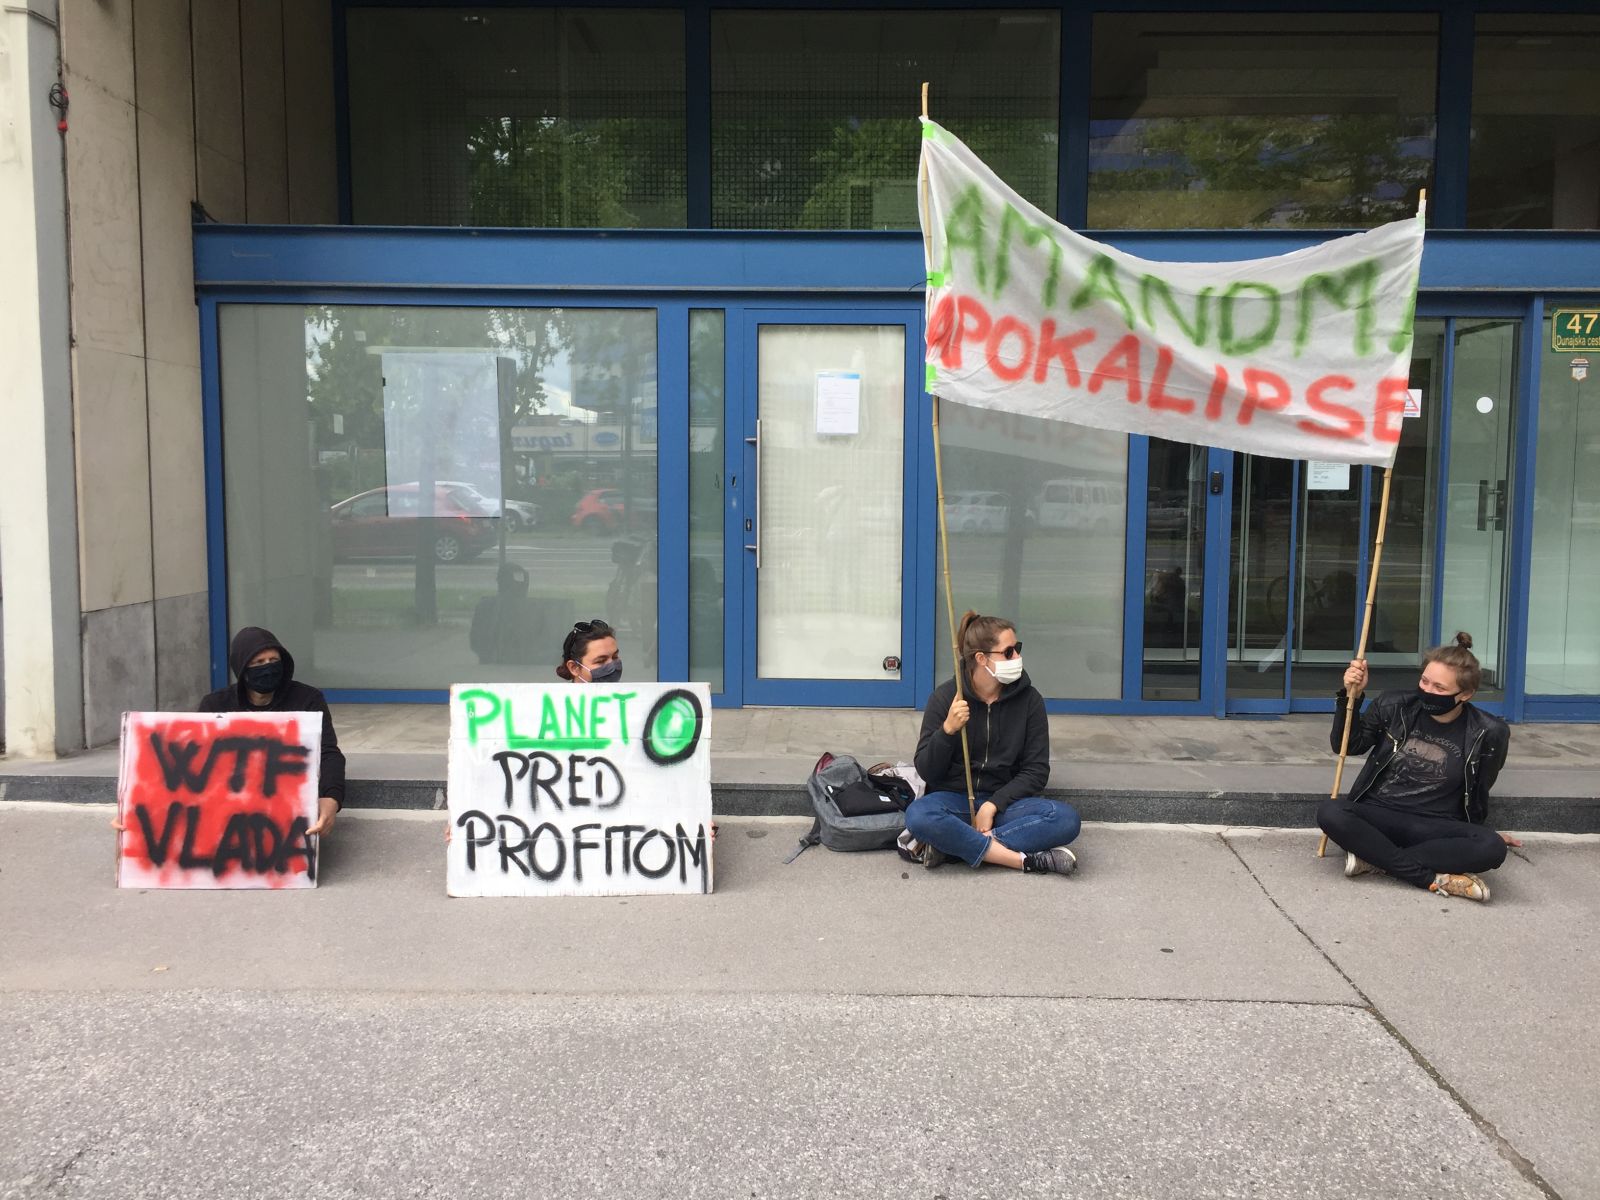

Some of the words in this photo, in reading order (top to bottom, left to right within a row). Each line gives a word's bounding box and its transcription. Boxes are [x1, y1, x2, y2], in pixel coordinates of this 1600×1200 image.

[1567, 313, 1598, 334] 47
[927, 295, 1410, 444] APOKALIPSE
[458, 689, 637, 747] PLANET
[150, 732, 310, 798] WTF
[492, 751, 626, 812] PRED
[136, 802, 316, 882] VLADA
[457, 809, 708, 893] PROFITOM
